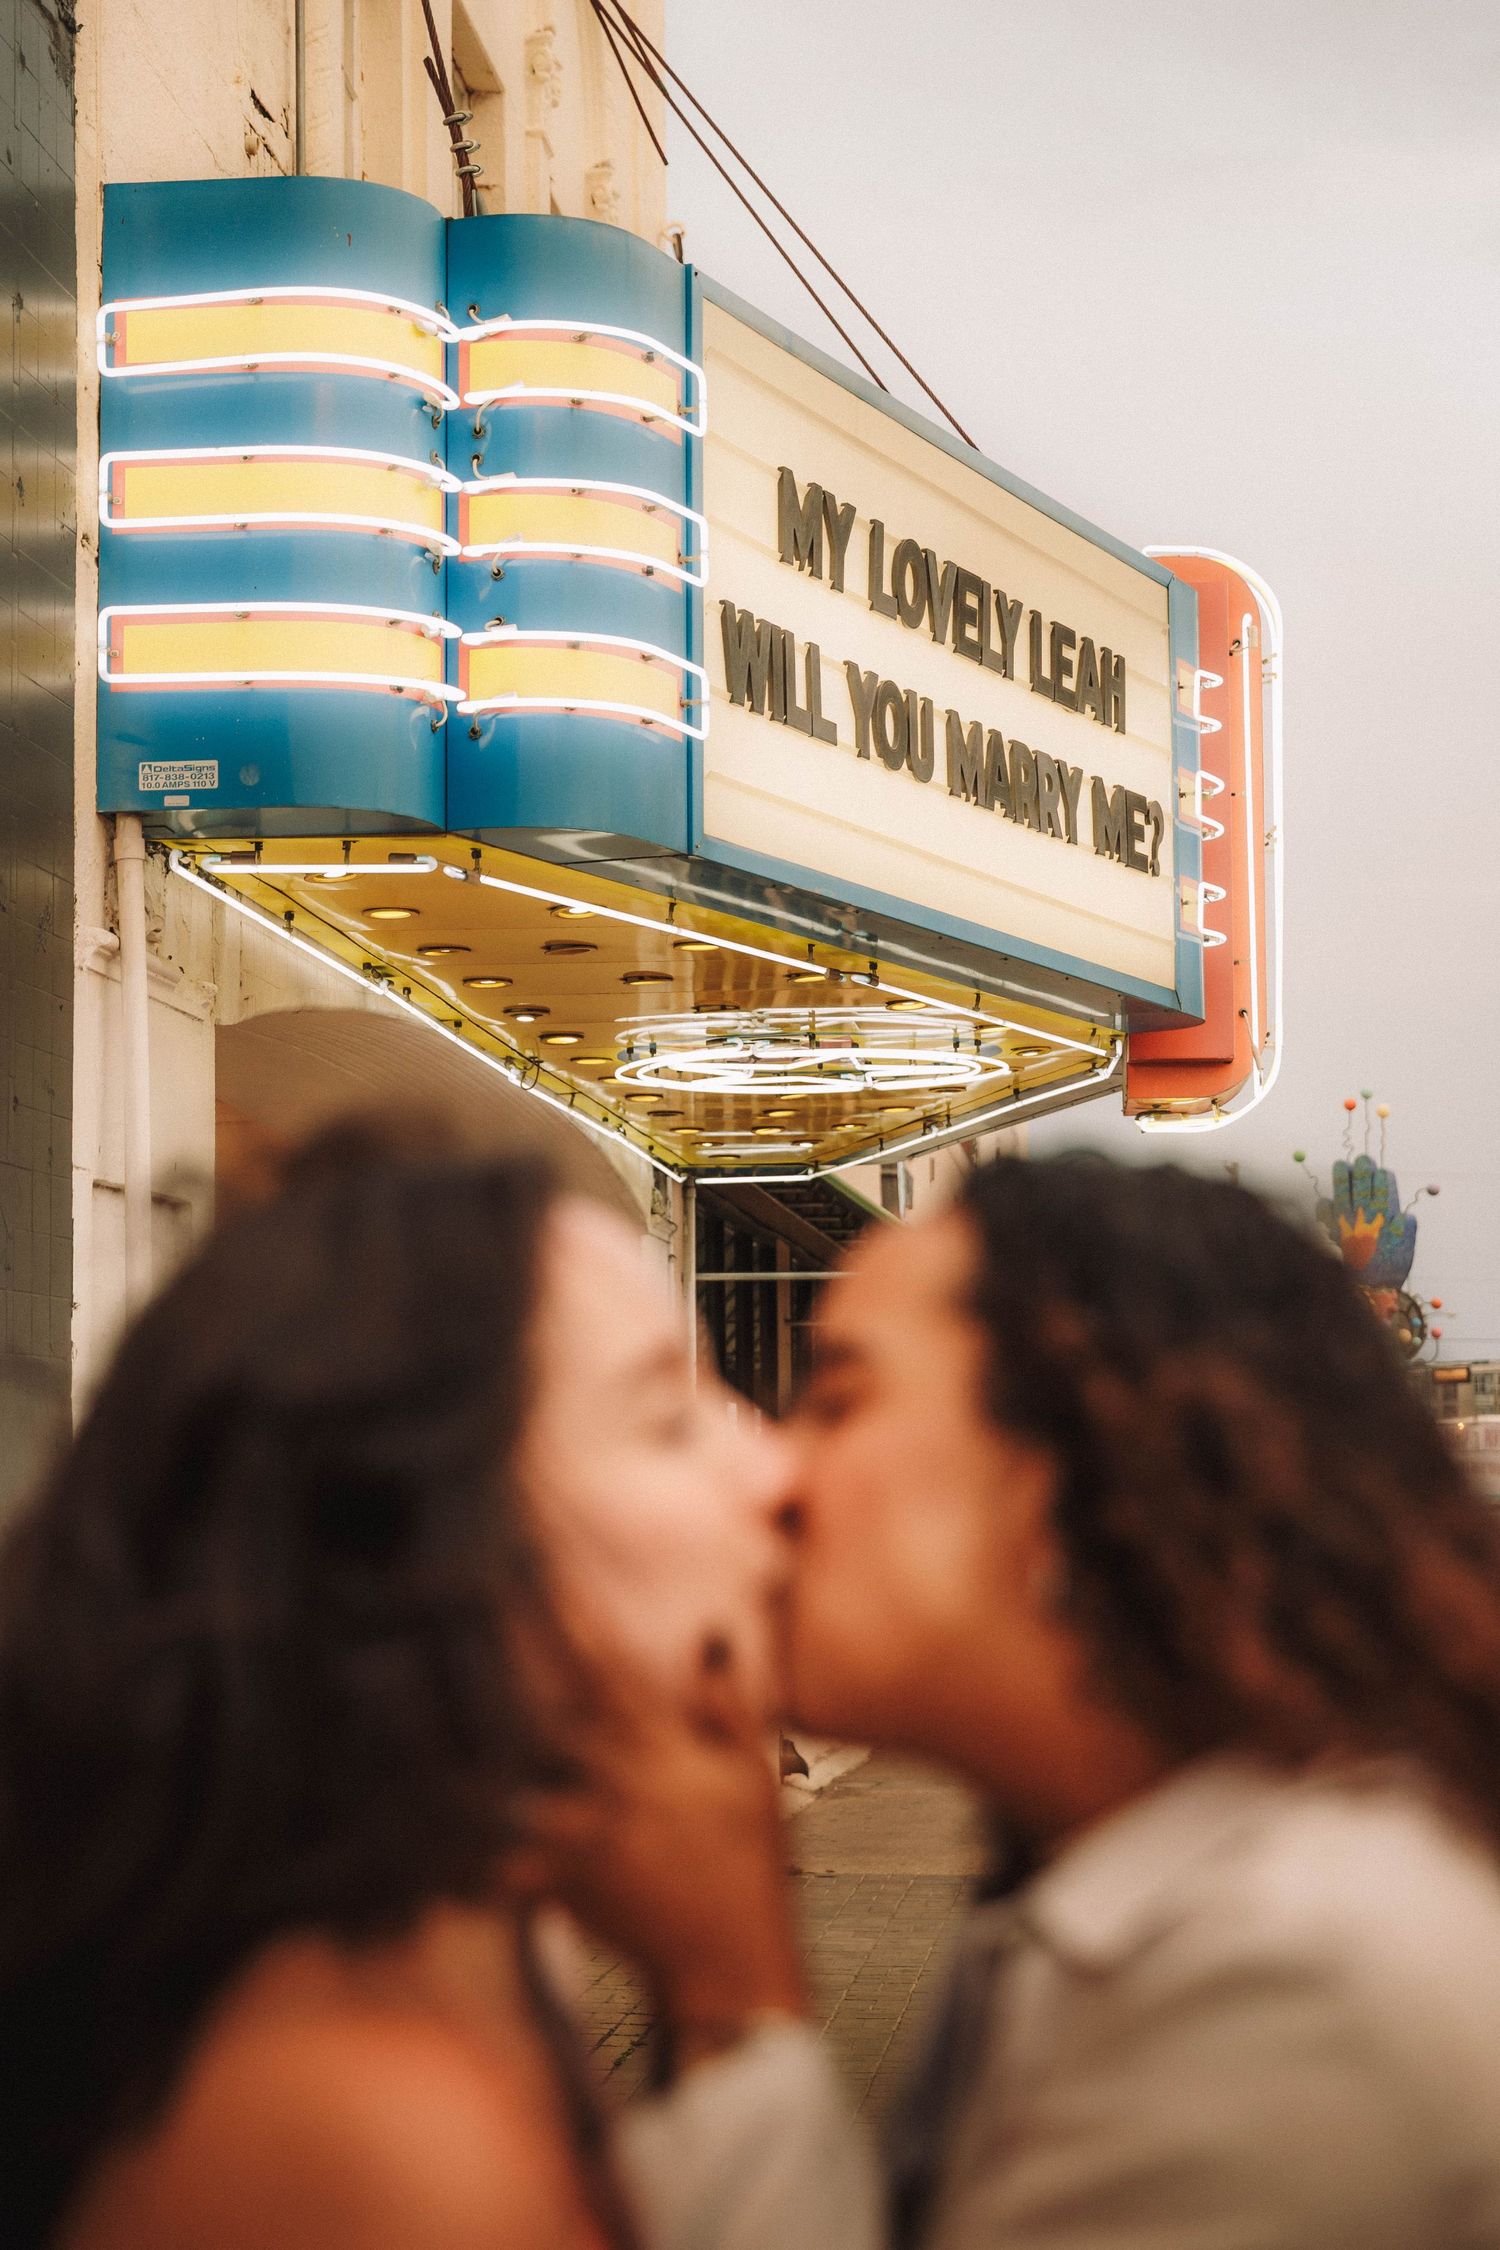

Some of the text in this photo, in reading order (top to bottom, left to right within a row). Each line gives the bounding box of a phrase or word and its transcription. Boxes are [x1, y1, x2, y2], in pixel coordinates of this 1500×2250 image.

[777, 466, 1126, 735] MY LOVELY LEAH
[719, 600, 1165, 878] WILL YOU MARRY ME?
[153, 764, 216, 773] DeltaSigns
[142, 772, 215, 781] 817-838-0213
[162, 780, 190, 788] AMPS
